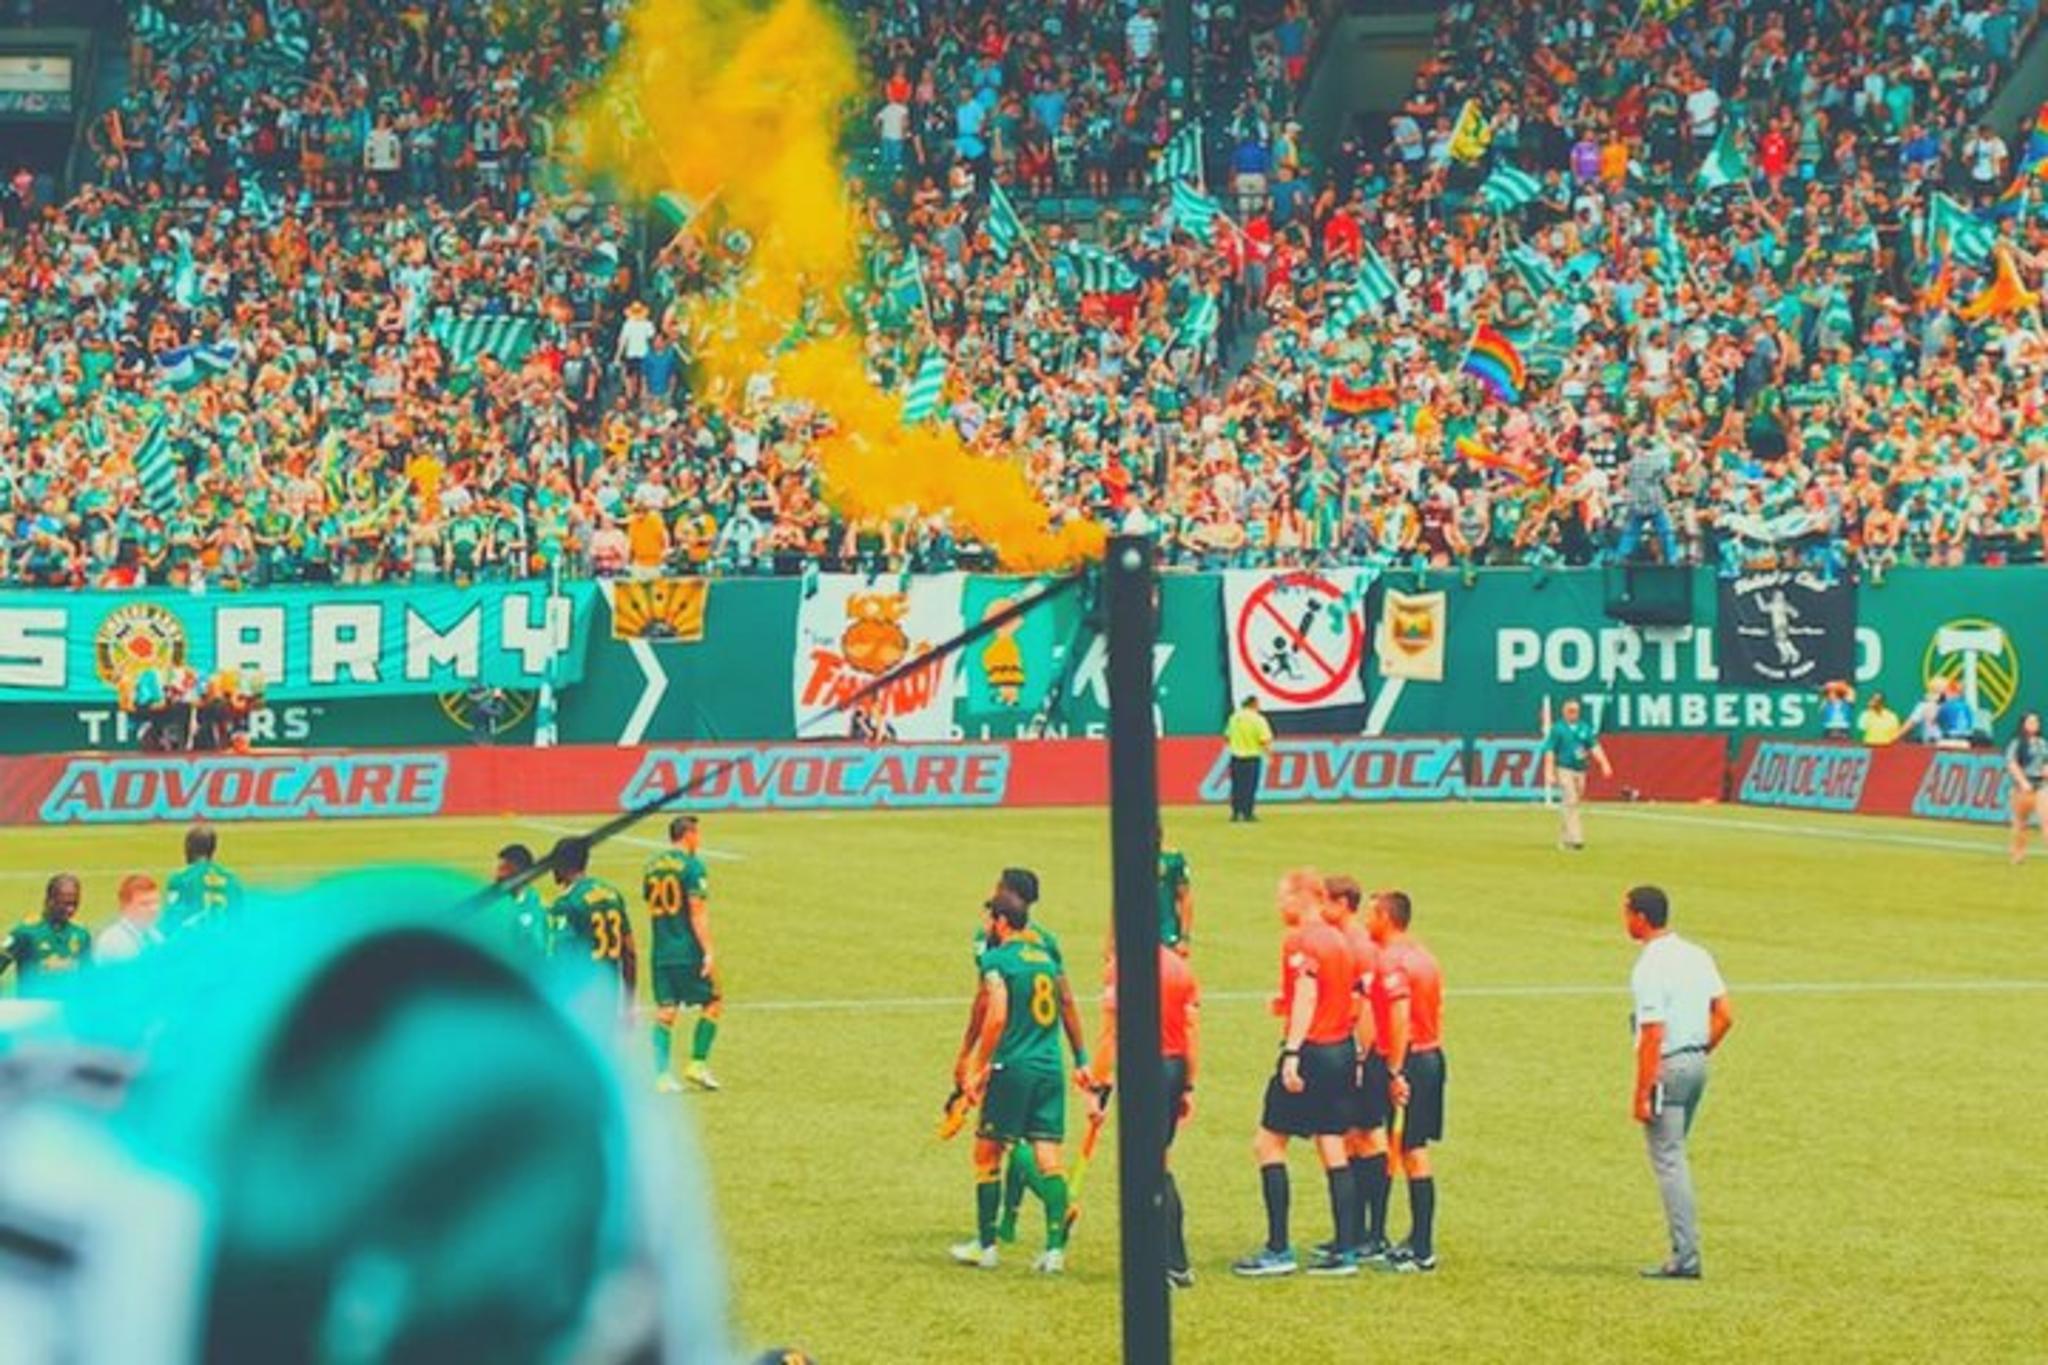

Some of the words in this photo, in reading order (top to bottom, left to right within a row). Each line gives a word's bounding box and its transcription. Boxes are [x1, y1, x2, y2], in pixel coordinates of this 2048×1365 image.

[215, 594, 572, 684] ARMY
[1583, 693, 1806, 728] TIMBERS
[54, 762, 438, 812] ADVOCARE
[632, 754, 1002, 800] ADVOCARE
[1752, 750, 1867, 799] ADVOCARE
[648, 874, 682, 916] 20
[591, 909, 622, 960] 33
[1031, 973, 1056, 1026] 8
